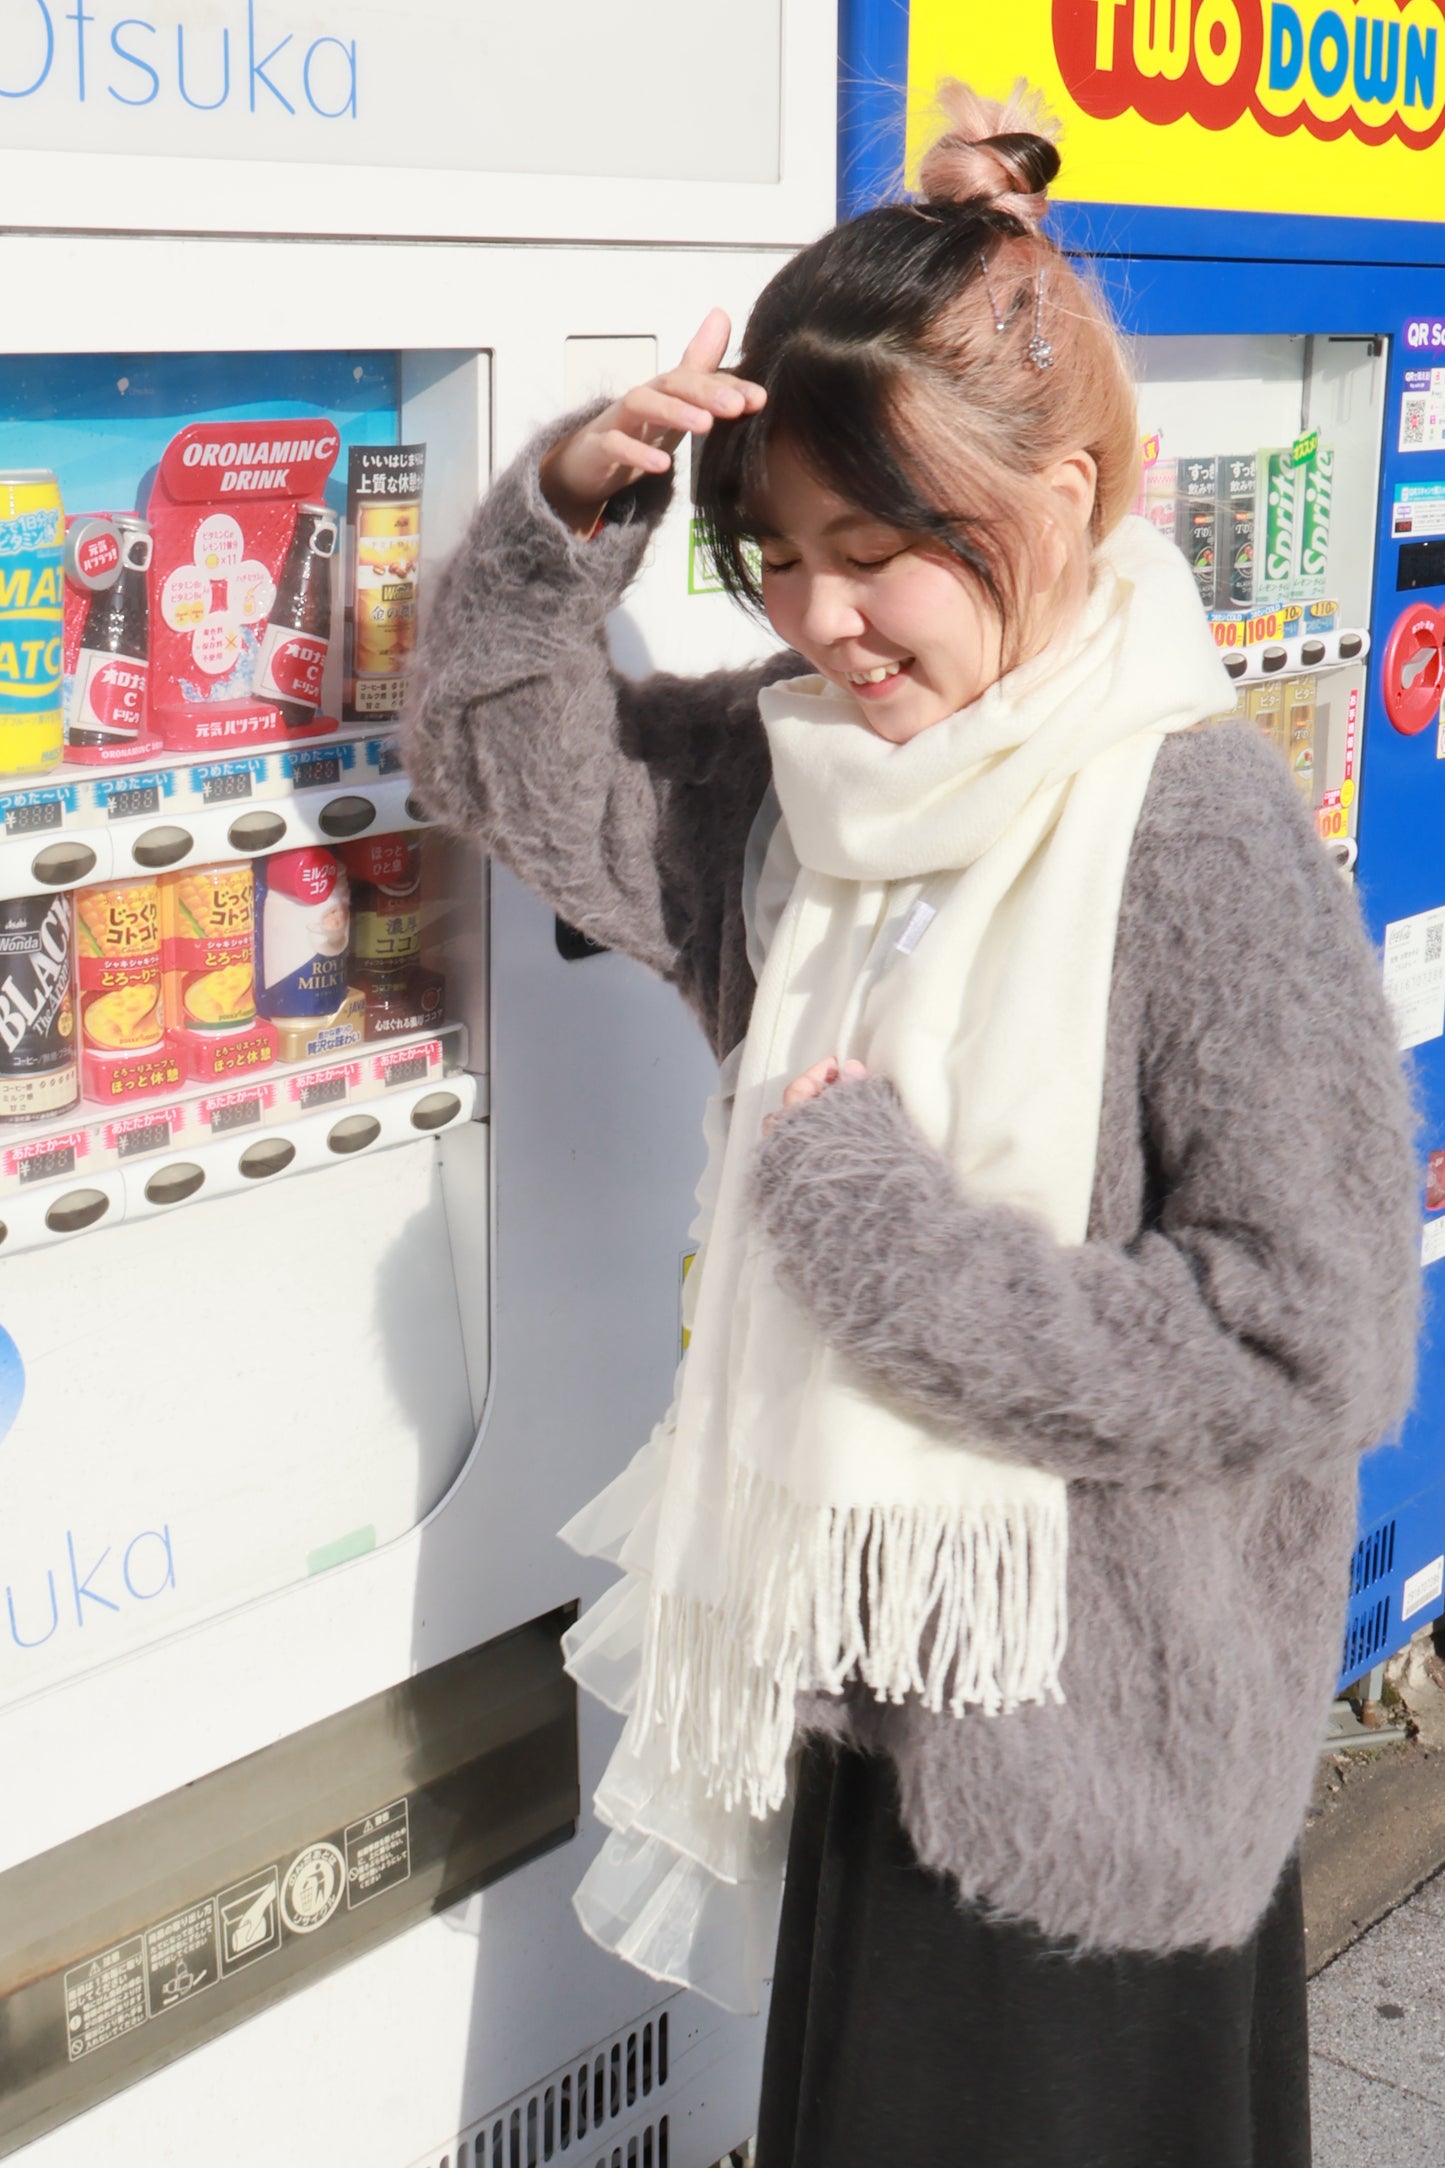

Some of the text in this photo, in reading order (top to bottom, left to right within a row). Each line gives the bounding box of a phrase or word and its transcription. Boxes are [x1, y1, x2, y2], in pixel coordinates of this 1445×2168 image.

[1269, 2, 1437, 111] DOWN
[1408, 322, 1429, 347] QR
[220, 469, 290, 492] DRINK
[88, 540, 108, 557] 元気
[307, 666, 318, 680] C
[124, 692, 137, 707] C
[310, 879, 328, 895] コク
[111, 904, 156, 926] じっくり
